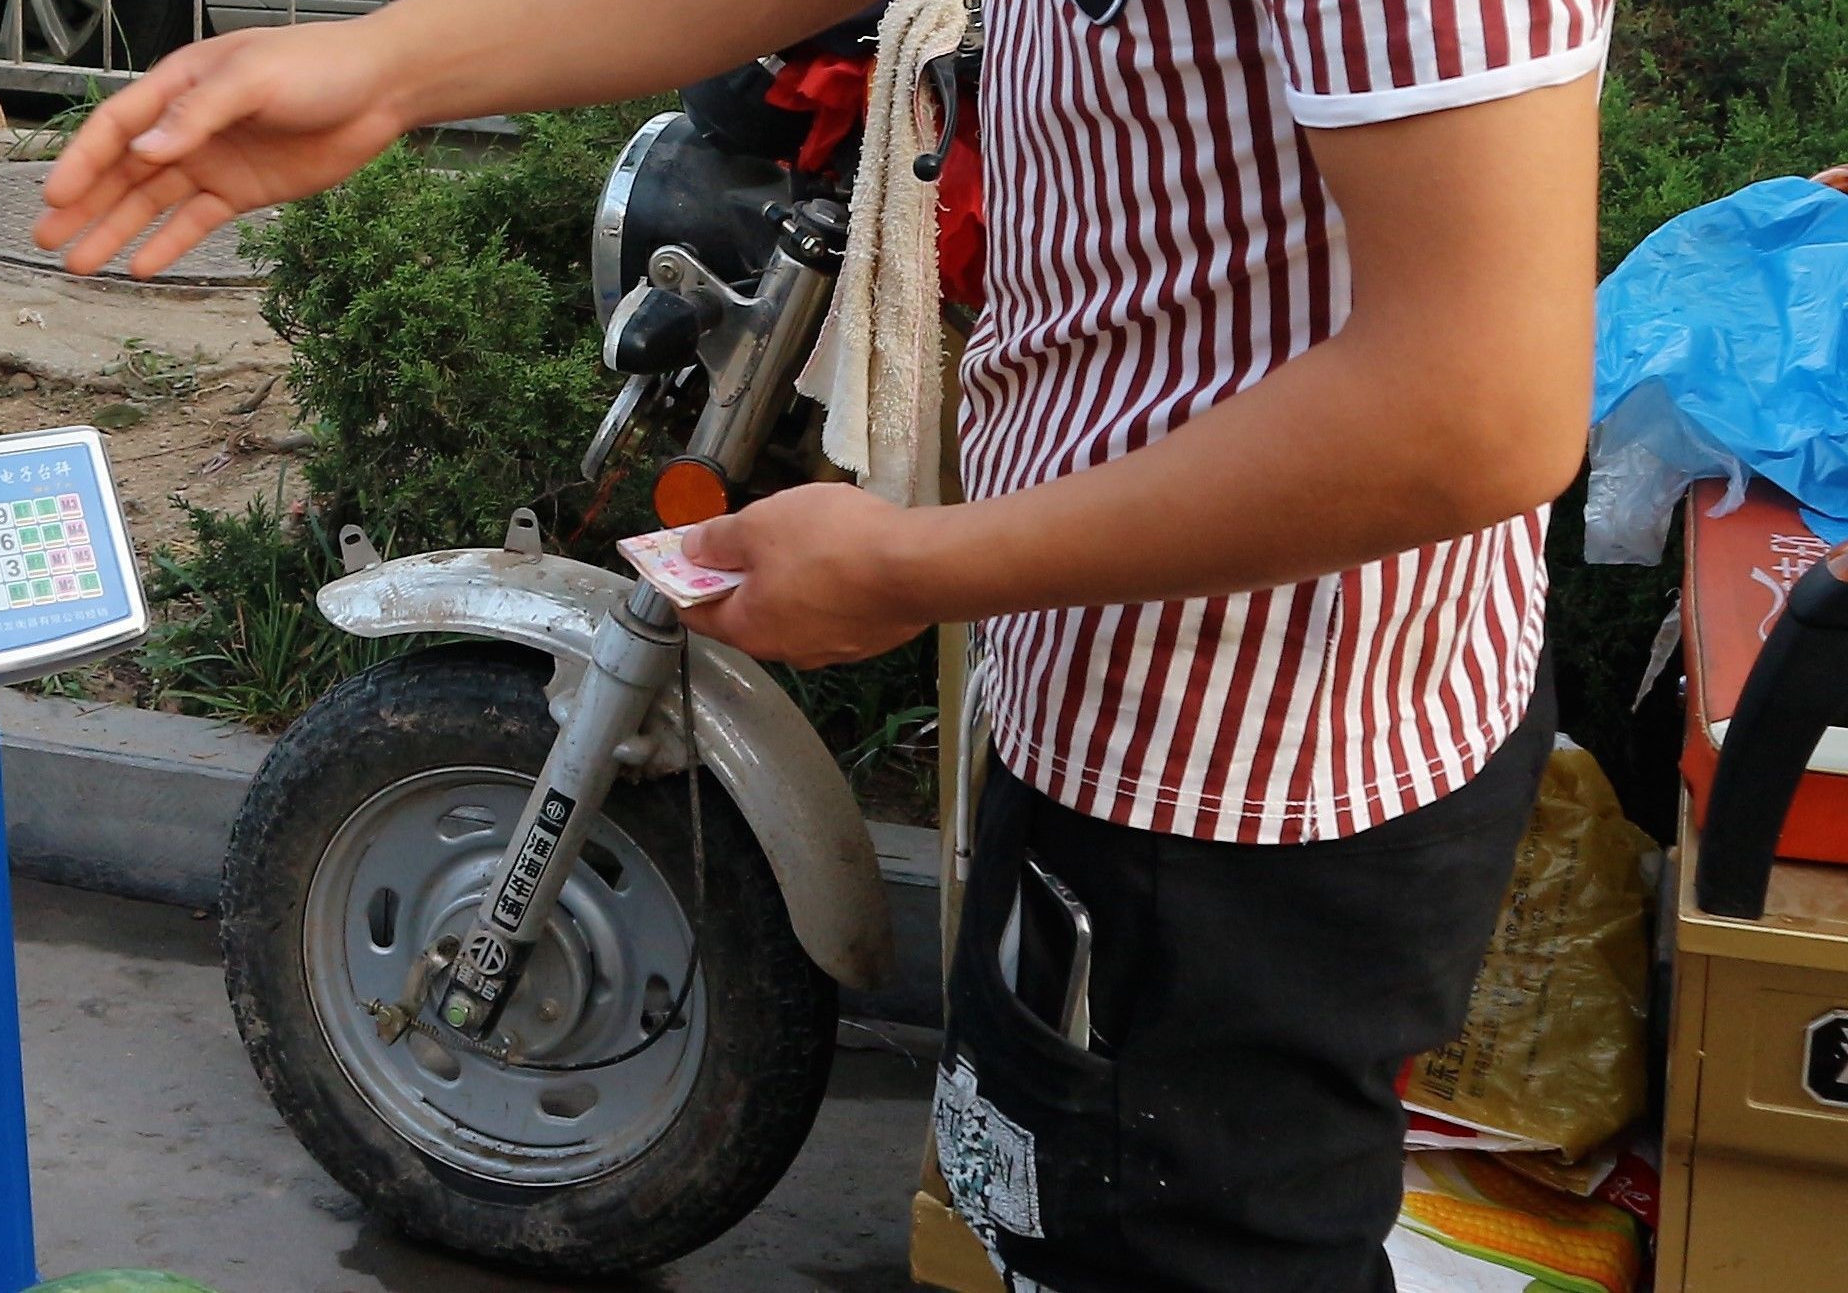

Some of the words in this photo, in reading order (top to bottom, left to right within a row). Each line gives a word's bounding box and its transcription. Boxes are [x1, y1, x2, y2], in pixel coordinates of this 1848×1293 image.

[61, 498, 77, 511] M3
[0, 533, 15, 551] 6
[6, 559, 21, 577] 3
